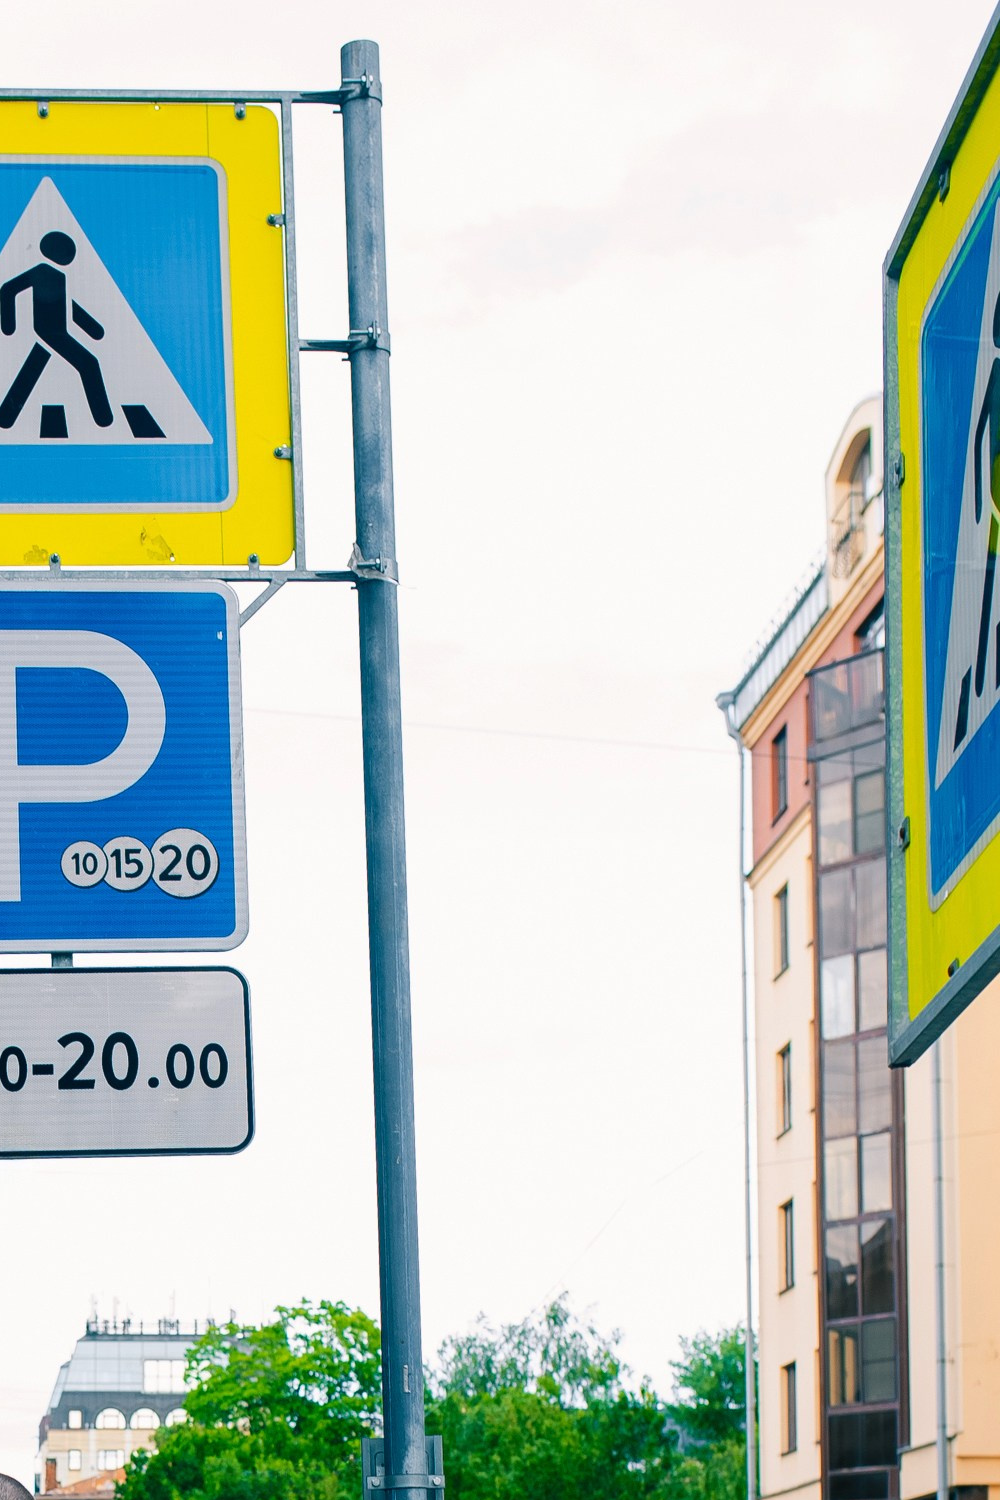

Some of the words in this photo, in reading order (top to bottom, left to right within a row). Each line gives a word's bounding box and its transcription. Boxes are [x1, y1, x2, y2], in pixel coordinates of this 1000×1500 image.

[71, 852, 98, 876] 10
[110, 848, 144, 879] 15
[158, 844, 212, 882] 20
